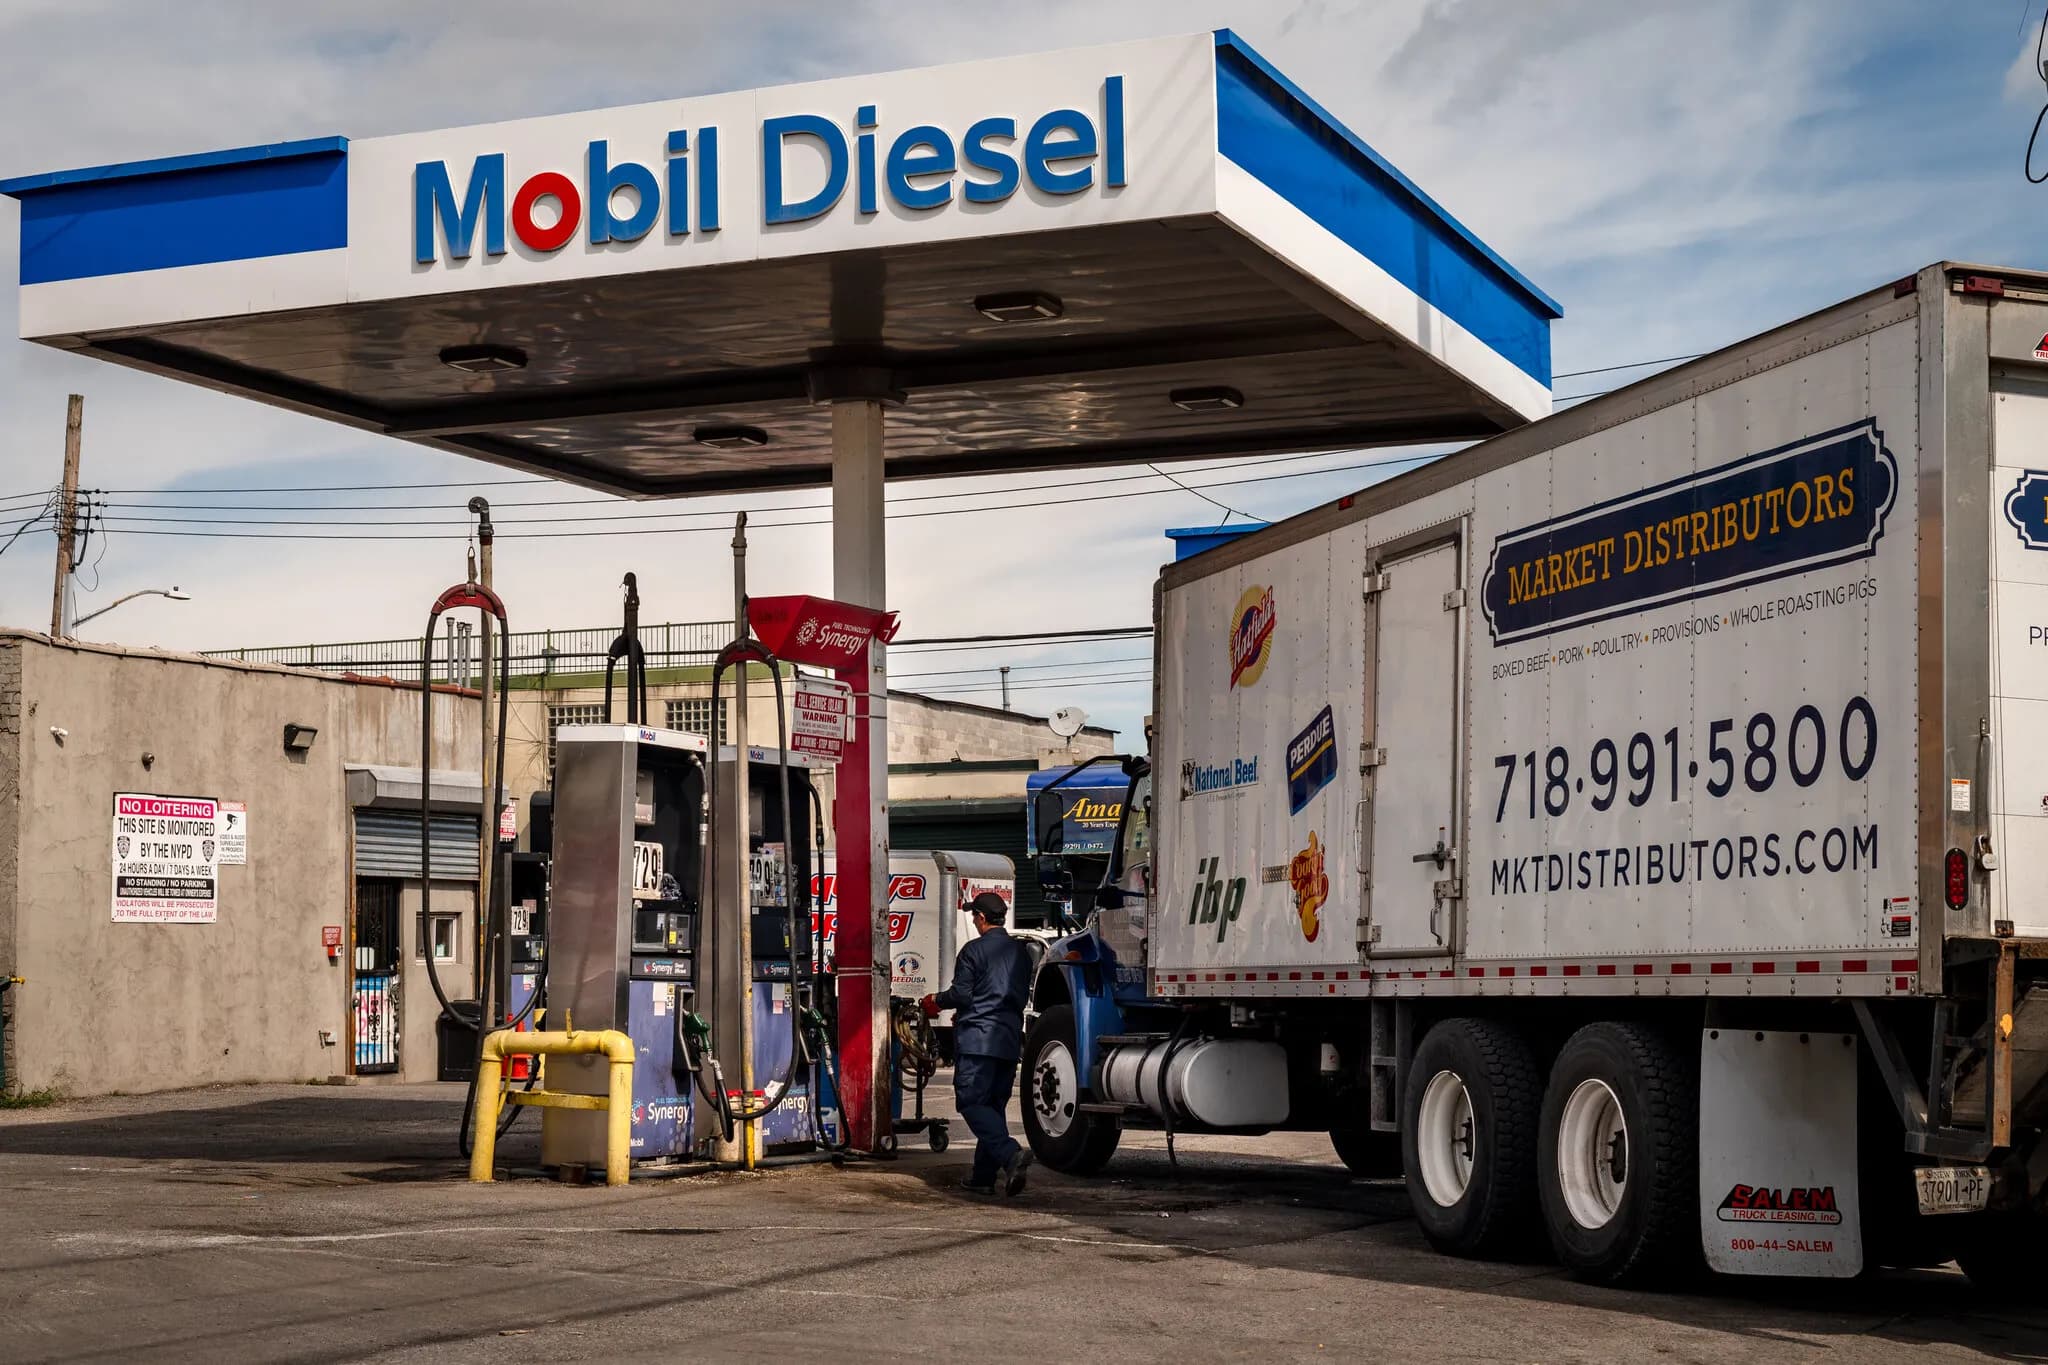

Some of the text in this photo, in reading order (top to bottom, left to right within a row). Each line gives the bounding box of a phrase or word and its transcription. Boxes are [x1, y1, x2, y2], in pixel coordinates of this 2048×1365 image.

[415, 75, 1128, 264] Mobil Diesel
[1508, 467, 1855, 605] MARKET DISTRIBUTORS
[1493, 578, 1877, 680] BOXED BEEF PORK POULTRY PROVISIONS WHOLE ROASTING PIGS
[816, 625, 866, 655] Synergy
[802, 711, 837, 724] WARNING
[640, 729, 656, 741] Mobil
[1290, 714, 1330, 769] PERDUE
[750, 750, 764, 761] Mobil
[1195, 755, 1257, 792] National Beef
[122, 801, 141, 812] NO
[145, 801, 211, 817] LOITERING
[118, 817, 215, 837] THIS SITE IS MONITORED
[140, 842, 193, 859] BY THE NYPD
[1492, 824, 1878, 896] MKTDISTRIBUTORS.COM
[120, 863, 127, 874] 24
[128, 863, 148, 874] HOURS
[149, 864, 153, 874] A
[154, 864, 165, 875] DAY
[174, 865, 189, 875] DAYS
[196, 865, 213, 876] WEEK
[125, 878, 135, 886] NO
[136, 879, 166, 887] STANDING
[170, 879, 179, 887] NO
[180, 880, 207, 888] PARKING
[176, 901, 214, 909] PROSECUTED
[1189, 857, 1246, 943] ibp
[155, 910, 178, 918] EXTENT
[652, 962, 673, 975] Synergy
[648, 1102, 690, 1125] Synergy
[773, 1096, 810, 1115] ynergy
[1731, 1184, 1835, 1210] SALEM
[1732, 1209, 1767, 1219] TRUCK
[1731, 1239, 1833, 1252] 800-44-SALEM
